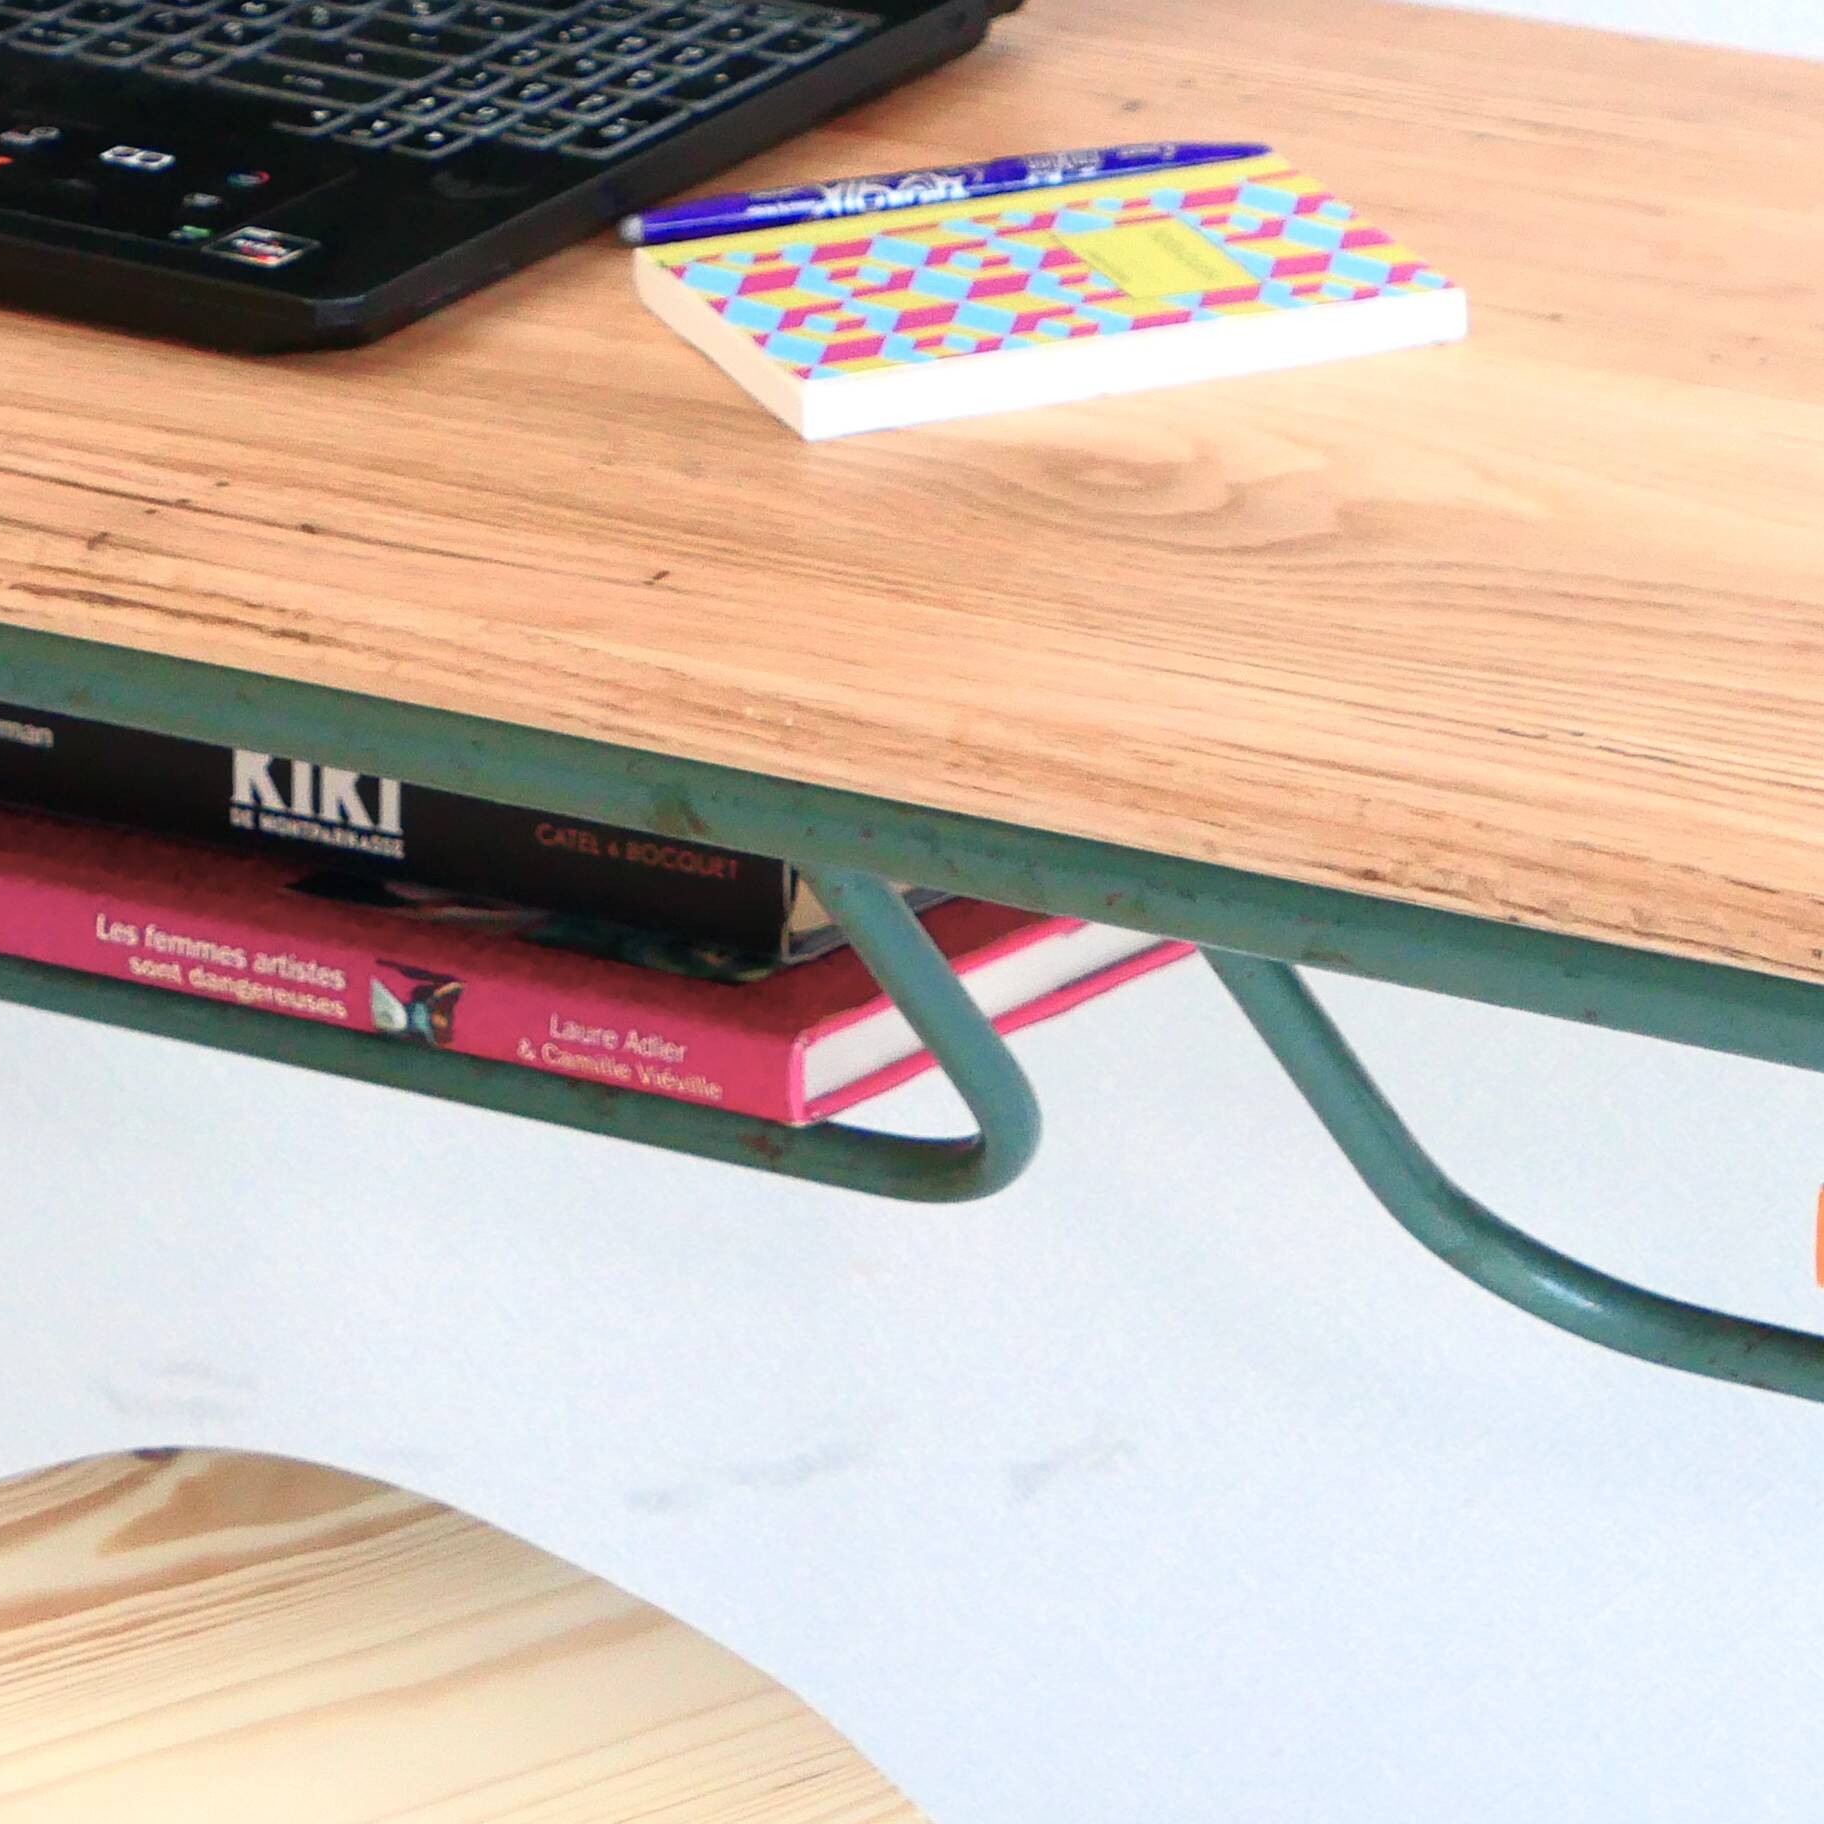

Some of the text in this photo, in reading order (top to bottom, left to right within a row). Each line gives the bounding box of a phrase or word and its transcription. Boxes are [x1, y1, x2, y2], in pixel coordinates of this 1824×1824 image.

[231, 748, 403, 836] KIKI
[535, 823, 600, 857] CATEL
[626, 840, 738, 879] BOCQUET
[95, 912, 346, 991] Les femmes artistes
[128, 956, 348, 1019] sont dangereuses
[516, 1037, 537, 1062] &
[540, 1042, 632, 1080] Camille
[548, 1012, 688, 1063] Laure Adler
